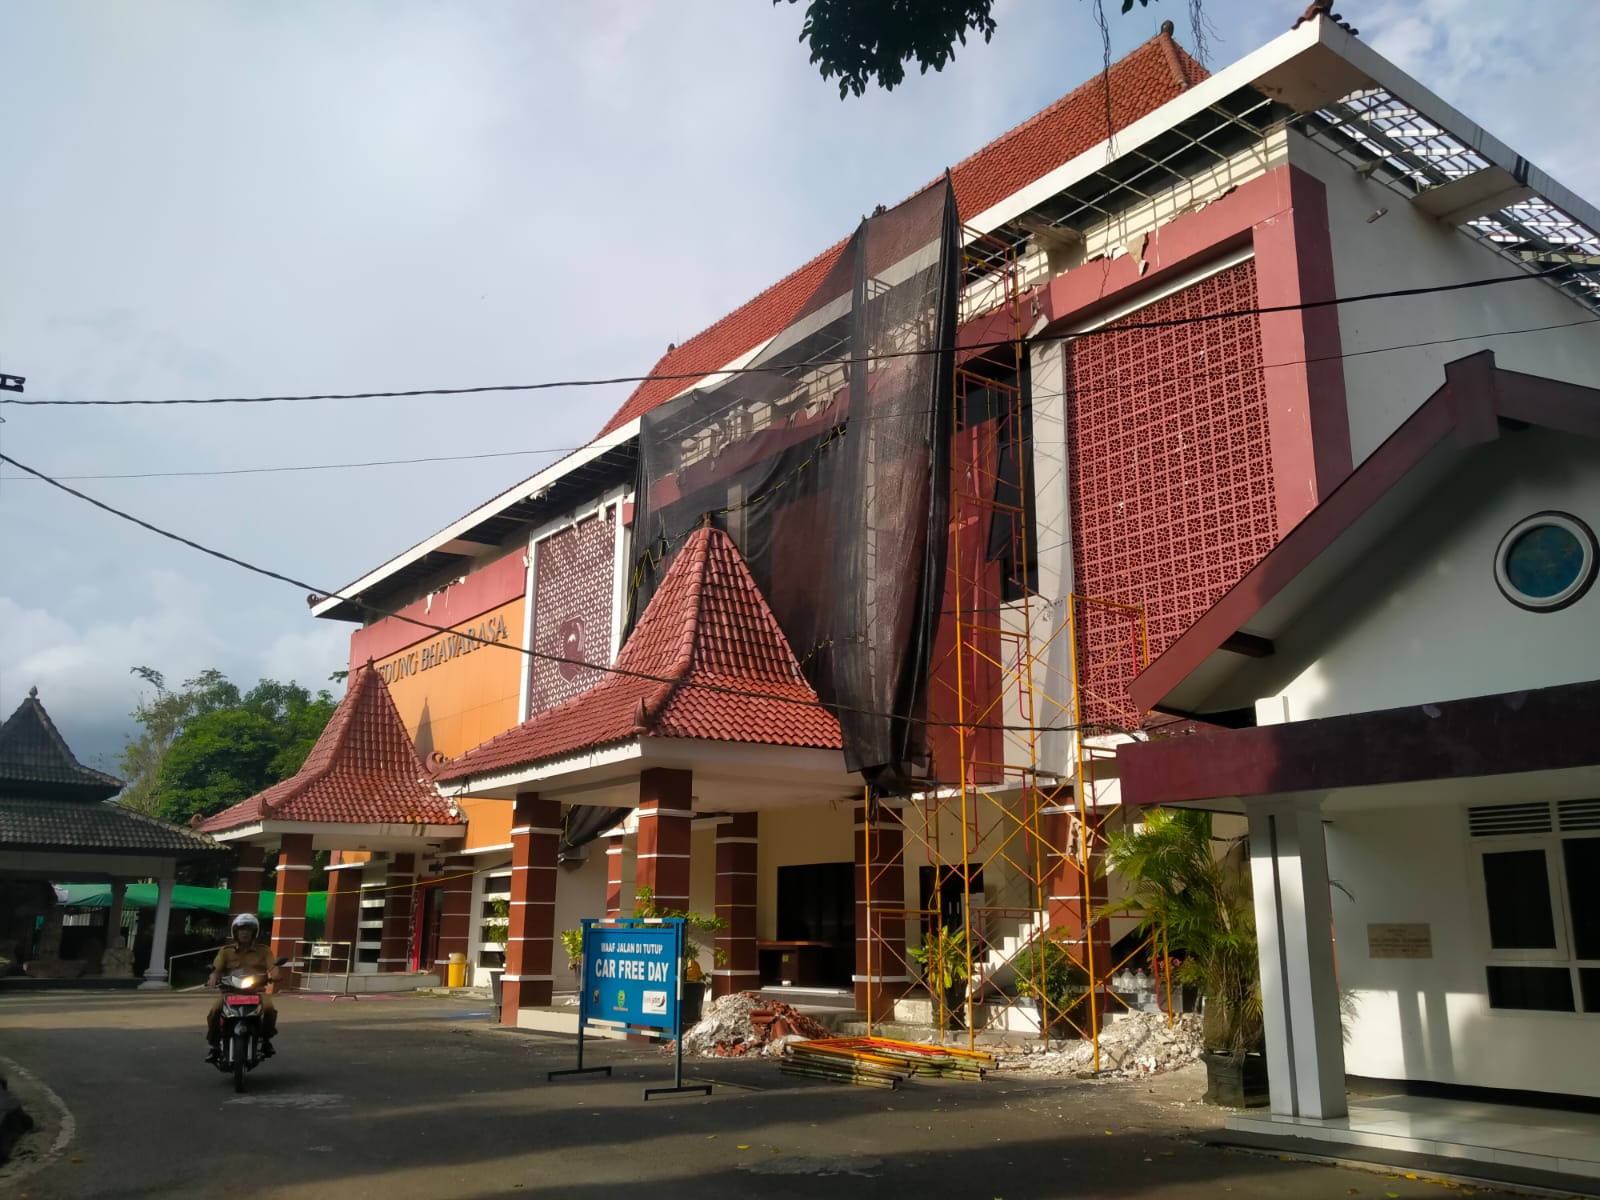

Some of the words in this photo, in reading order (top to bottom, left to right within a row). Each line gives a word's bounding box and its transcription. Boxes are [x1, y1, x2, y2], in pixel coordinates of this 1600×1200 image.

[421, 615, 508, 671] BHAWARASA
[617, 943, 635, 954] JALAN
[636, 943, 642, 954] DI
[643, 944, 663, 955] TUTUP
[595, 958, 616, 978] CAR
[618, 959, 645, 981] FREE
[648, 961, 669, 983] DAY
